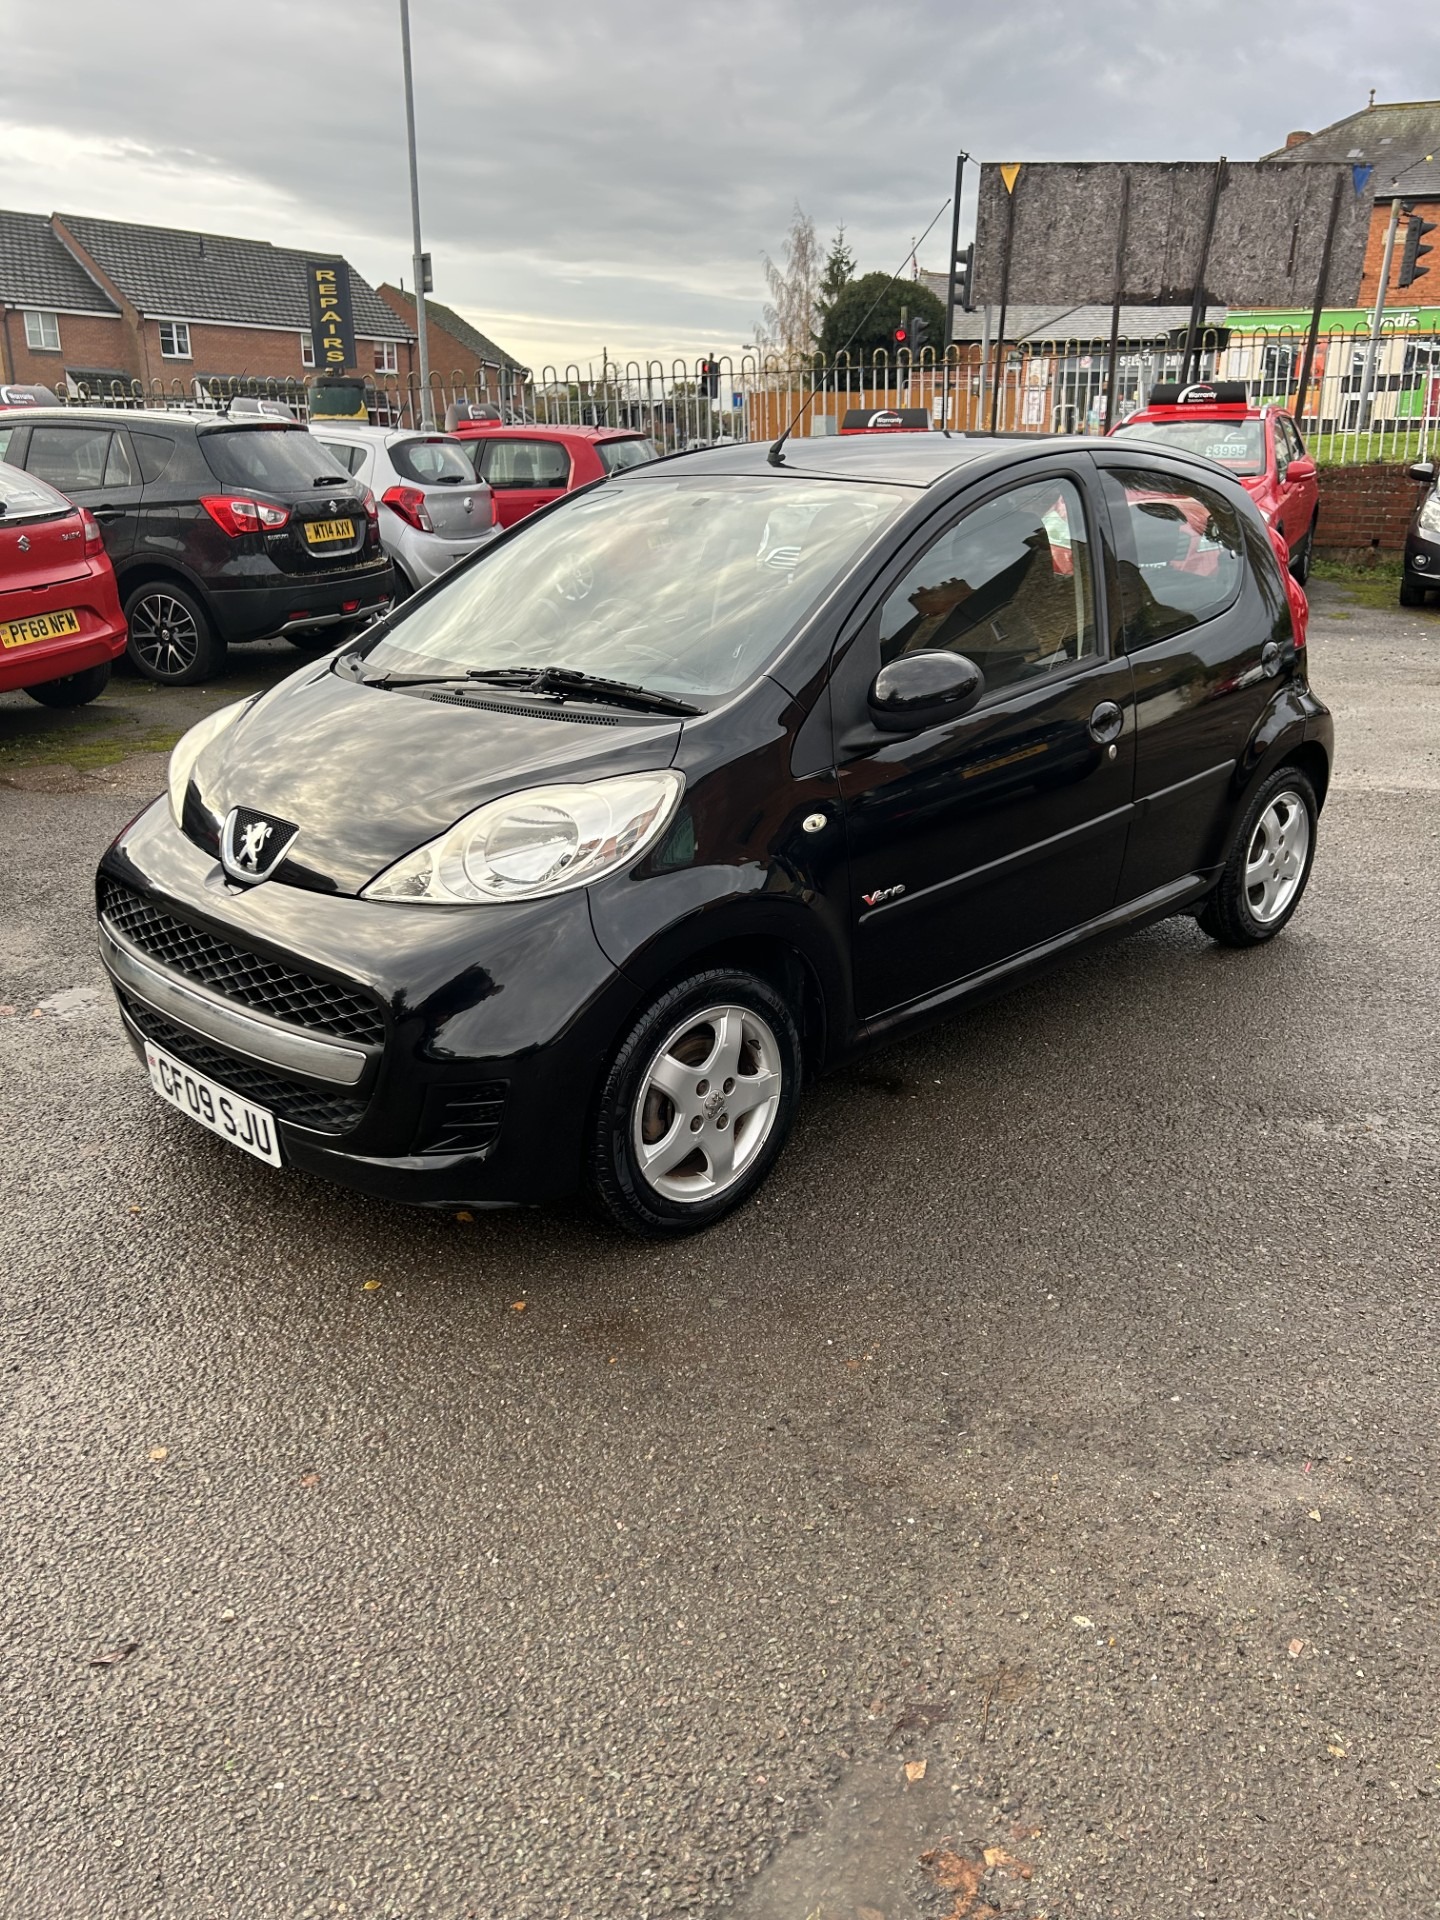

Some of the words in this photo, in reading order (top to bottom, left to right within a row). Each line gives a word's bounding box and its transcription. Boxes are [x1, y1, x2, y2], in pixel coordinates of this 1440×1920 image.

[315, 269, 345, 363] REPAIRS
[1367, 312, 1418, 328] Lndis
[1187, 391, 1218, 399] Warranty
[1205, 445, 1246, 458] £3995
[9, 618, 49, 643] PF68
[219, 1096, 272, 1156] SJU
